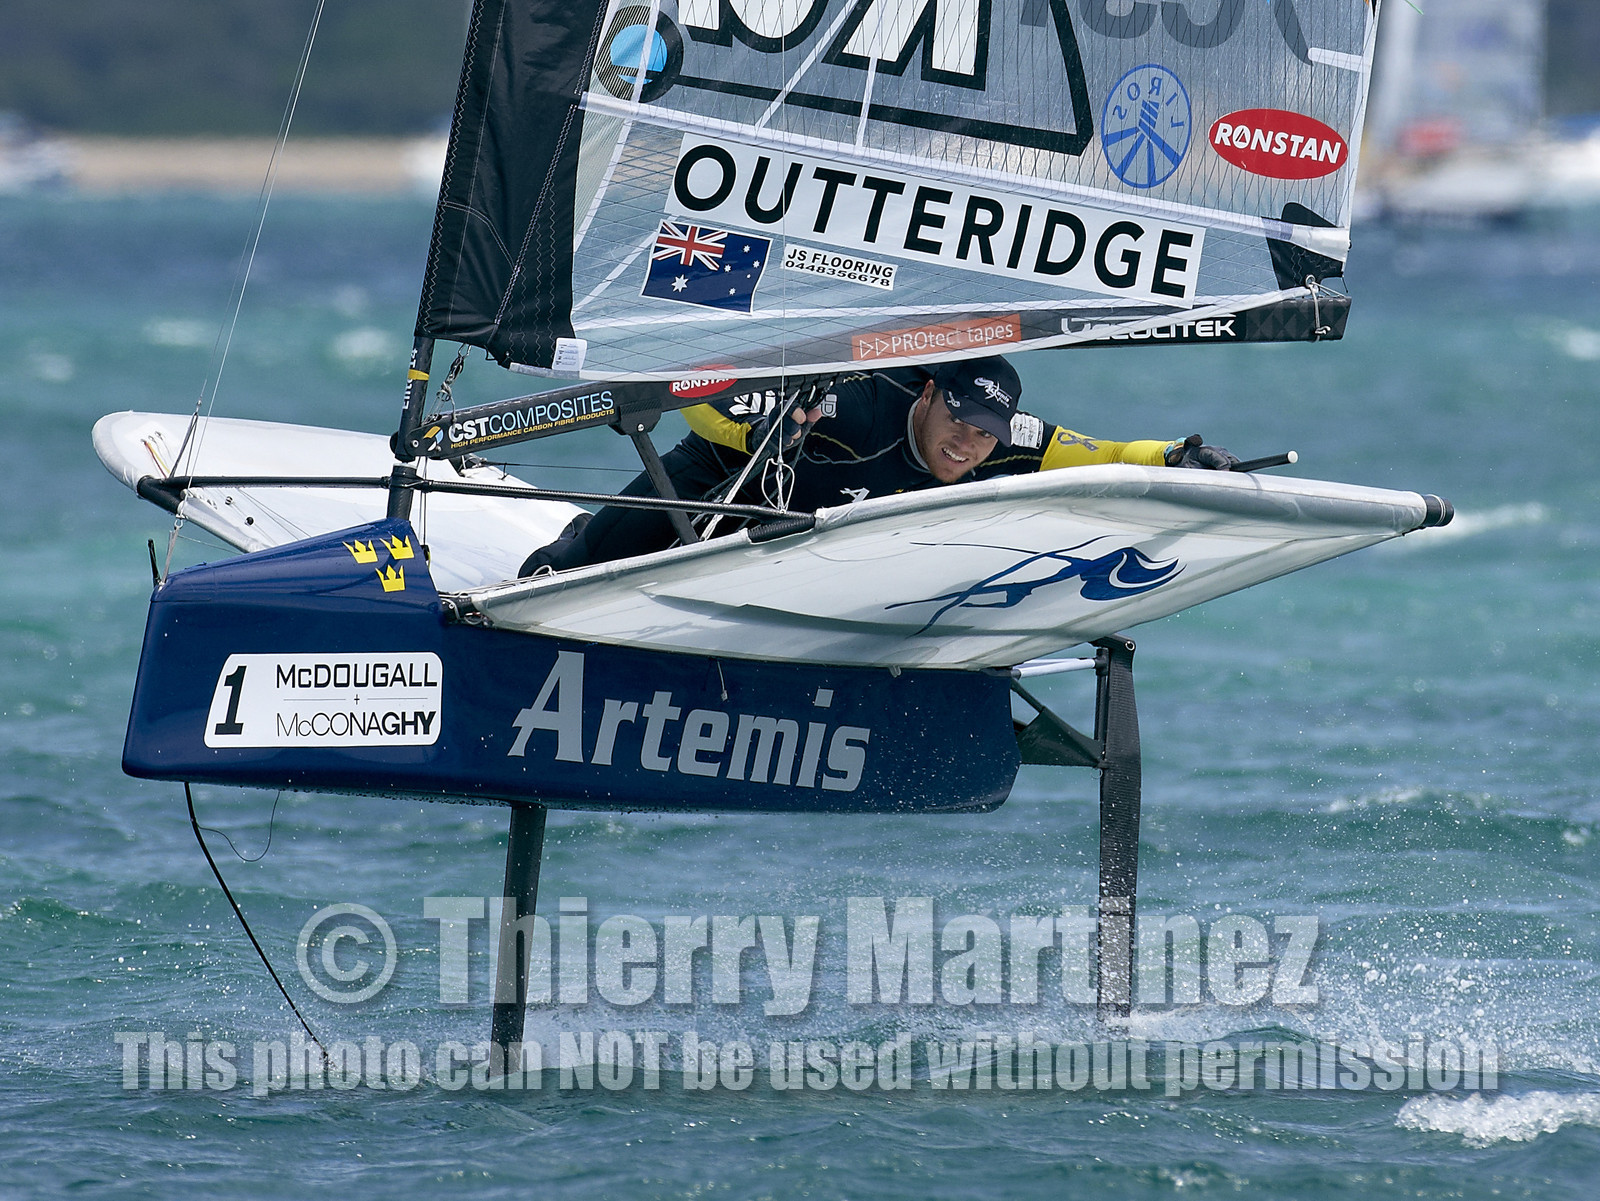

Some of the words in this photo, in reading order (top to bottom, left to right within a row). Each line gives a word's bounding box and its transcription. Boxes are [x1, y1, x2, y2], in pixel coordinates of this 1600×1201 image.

[1214, 123, 1341, 164] RONSTAN
[674, 144, 1194, 298] OUTTERIDGE
[785, 261, 890, 286] 0448356678
[788, 249, 807, 261] JS
[812, 253, 893, 278] FLOORING
[892, 331, 963, 353] PROtect
[968, 324, 1014, 345] tapes
[451, 440, 468, 449] HIGH
[470, 429, 522, 444] PERFORMANCE
[523, 422, 554, 434] CARBON
[554, 417, 575, 427] FIBRE
[576, 408, 615, 422] PRODUCTS
[276, 663, 438, 688] McDOUGALL
[214, 665, 247, 735] 1
[276, 711, 437, 737] McCONAGHY
[508, 650, 870, 791] Artemis
